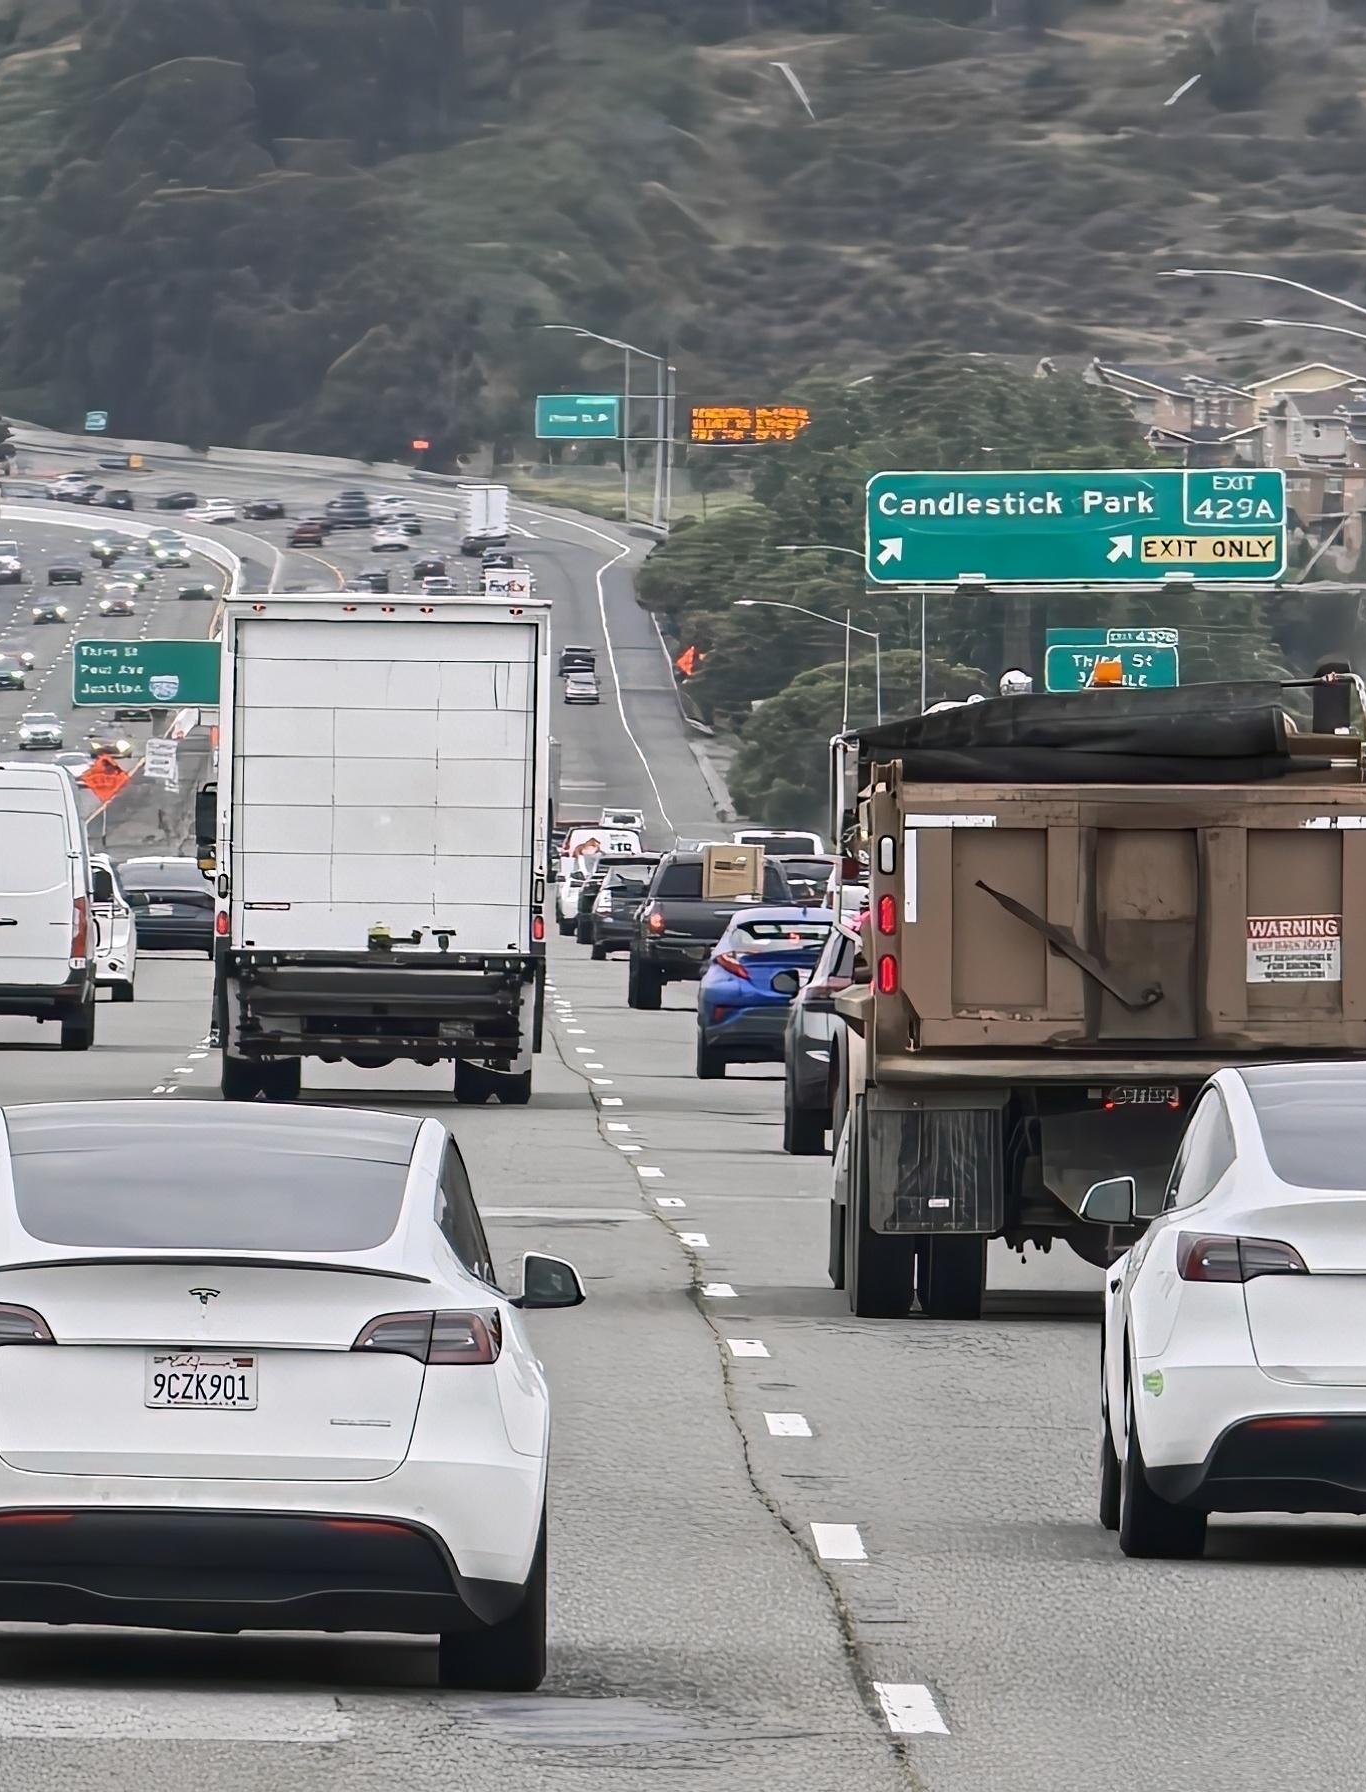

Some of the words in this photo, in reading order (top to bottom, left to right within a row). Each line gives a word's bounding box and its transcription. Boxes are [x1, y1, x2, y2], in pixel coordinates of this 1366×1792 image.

[1213, 475, 1256, 491] EXIT
[878, 492, 1063, 516] Candlestick
[1084, 490, 1155, 514] Park
[1194, 498, 1275, 519] 429A
[1143, 540, 1197, 558] EXIT
[1212, 540, 1273, 558] ONLY
[1132, 653, 1153, 667] St
[1249, 919, 1339, 937] WARNING
[153, 1373, 249, 1401] 9CZK901
